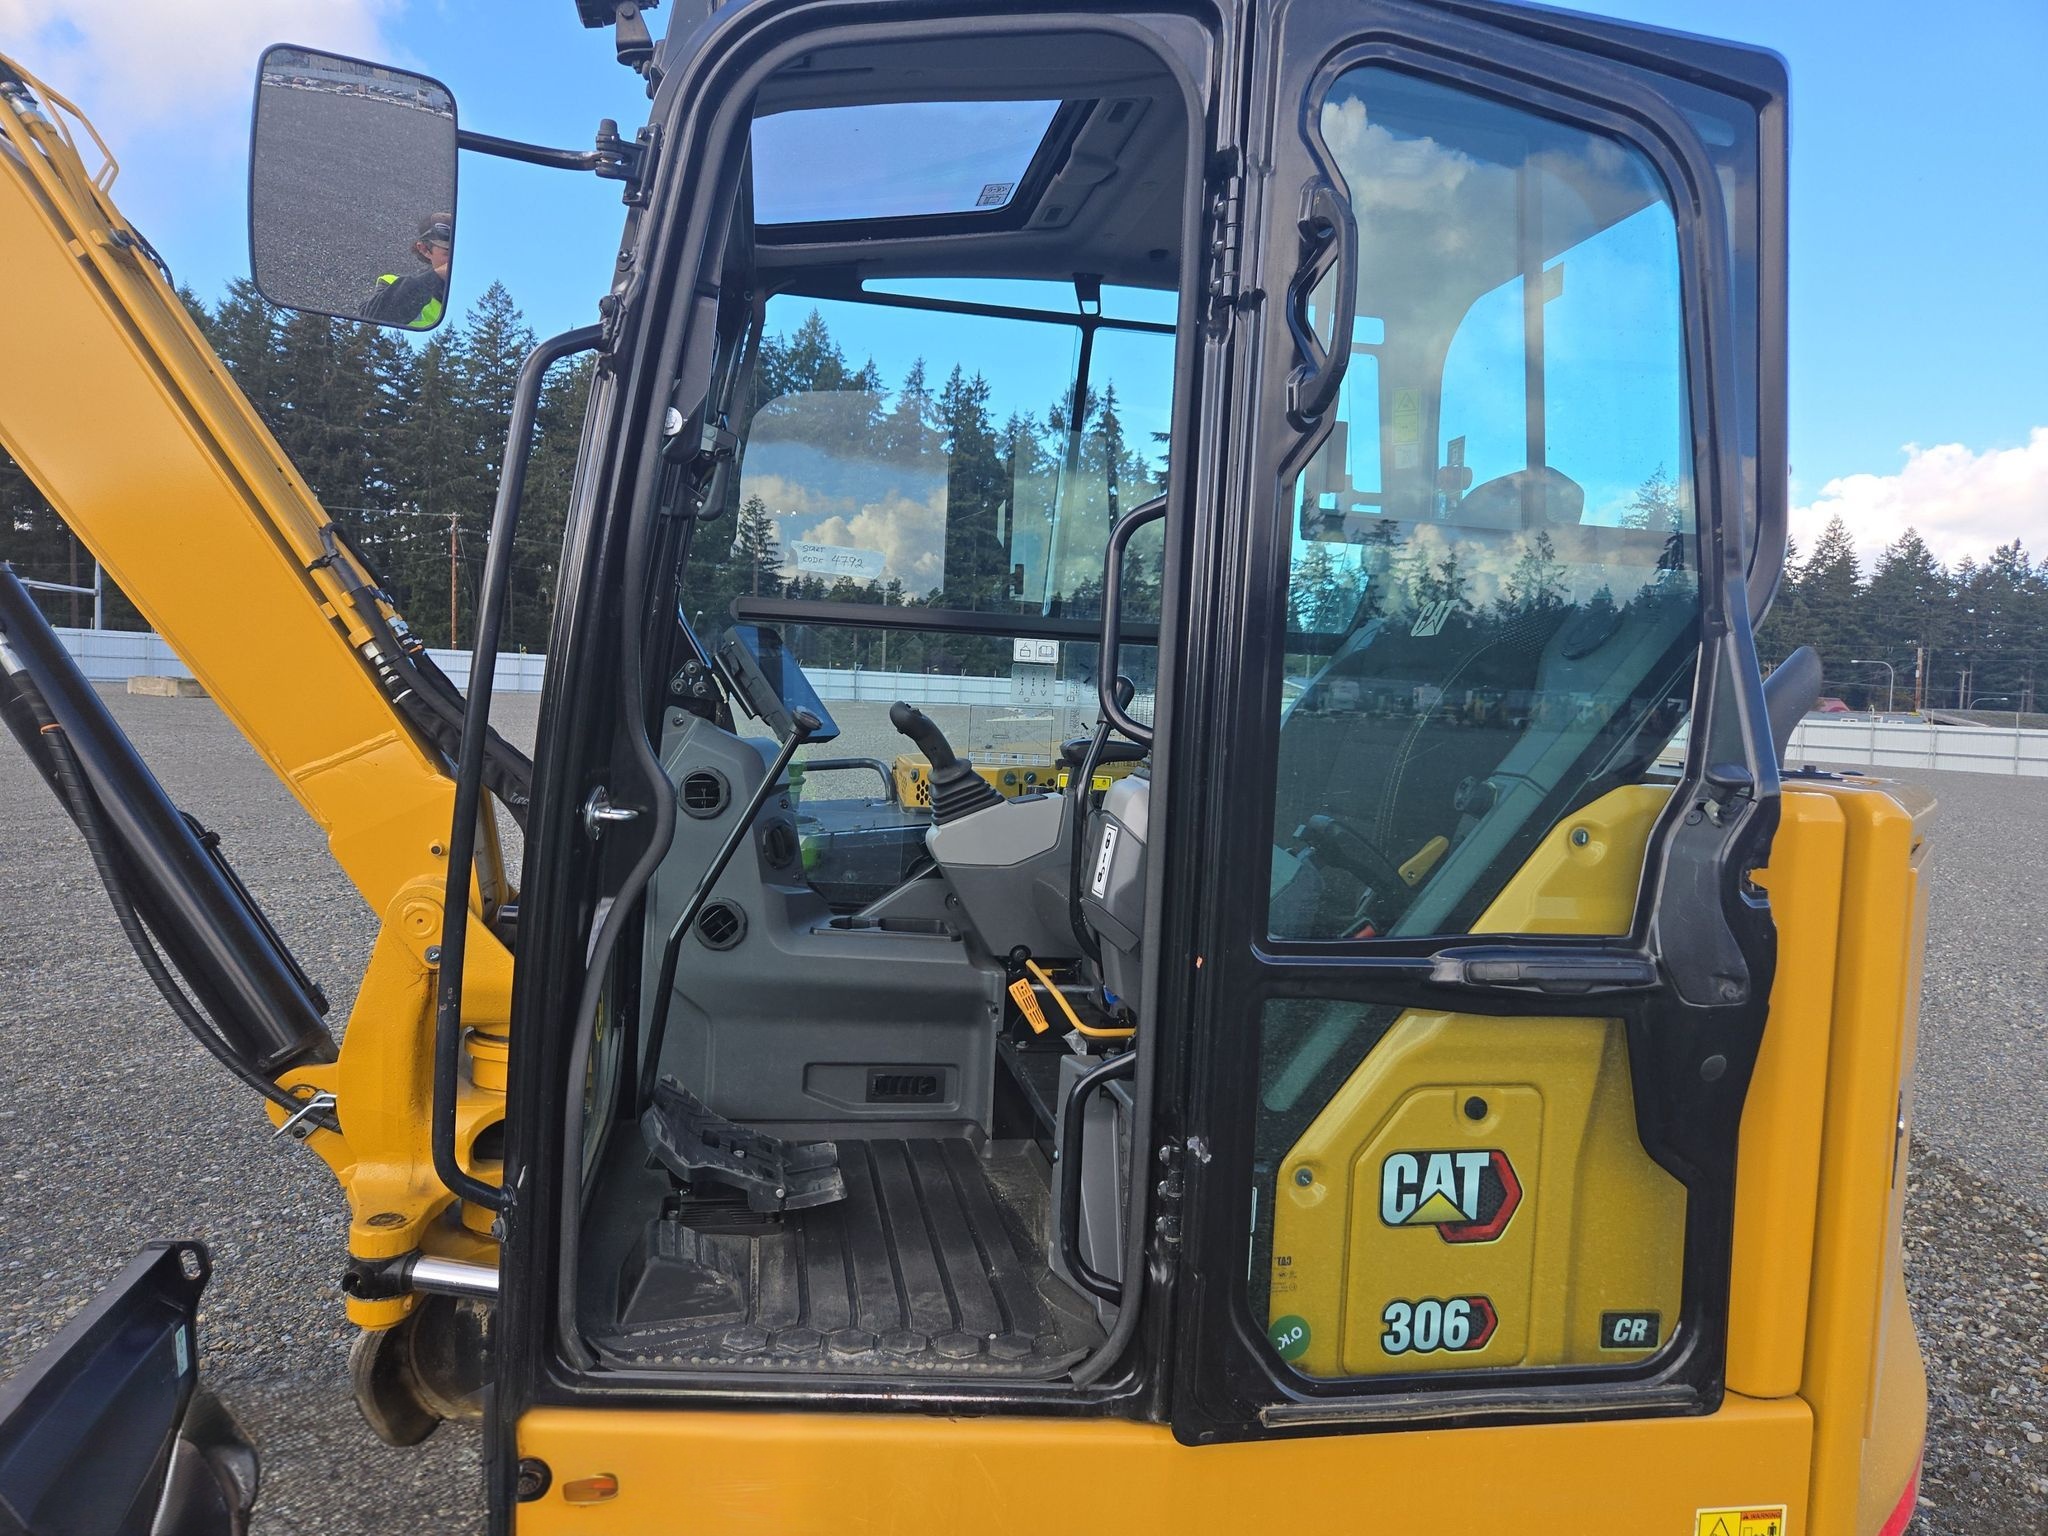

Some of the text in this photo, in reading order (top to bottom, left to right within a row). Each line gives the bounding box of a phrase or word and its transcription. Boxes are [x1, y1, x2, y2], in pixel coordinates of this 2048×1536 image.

[831, 553, 864, 569] 4792
[1410, 598, 1460, 637] CAT
[1382, 1151, 1490, 1224] CAT
[1383, 1299, 1471, 1352] 306
[1612, 1317, 1647, 1342] CR
[1750, 1511, 1780, 1520] WARNING
